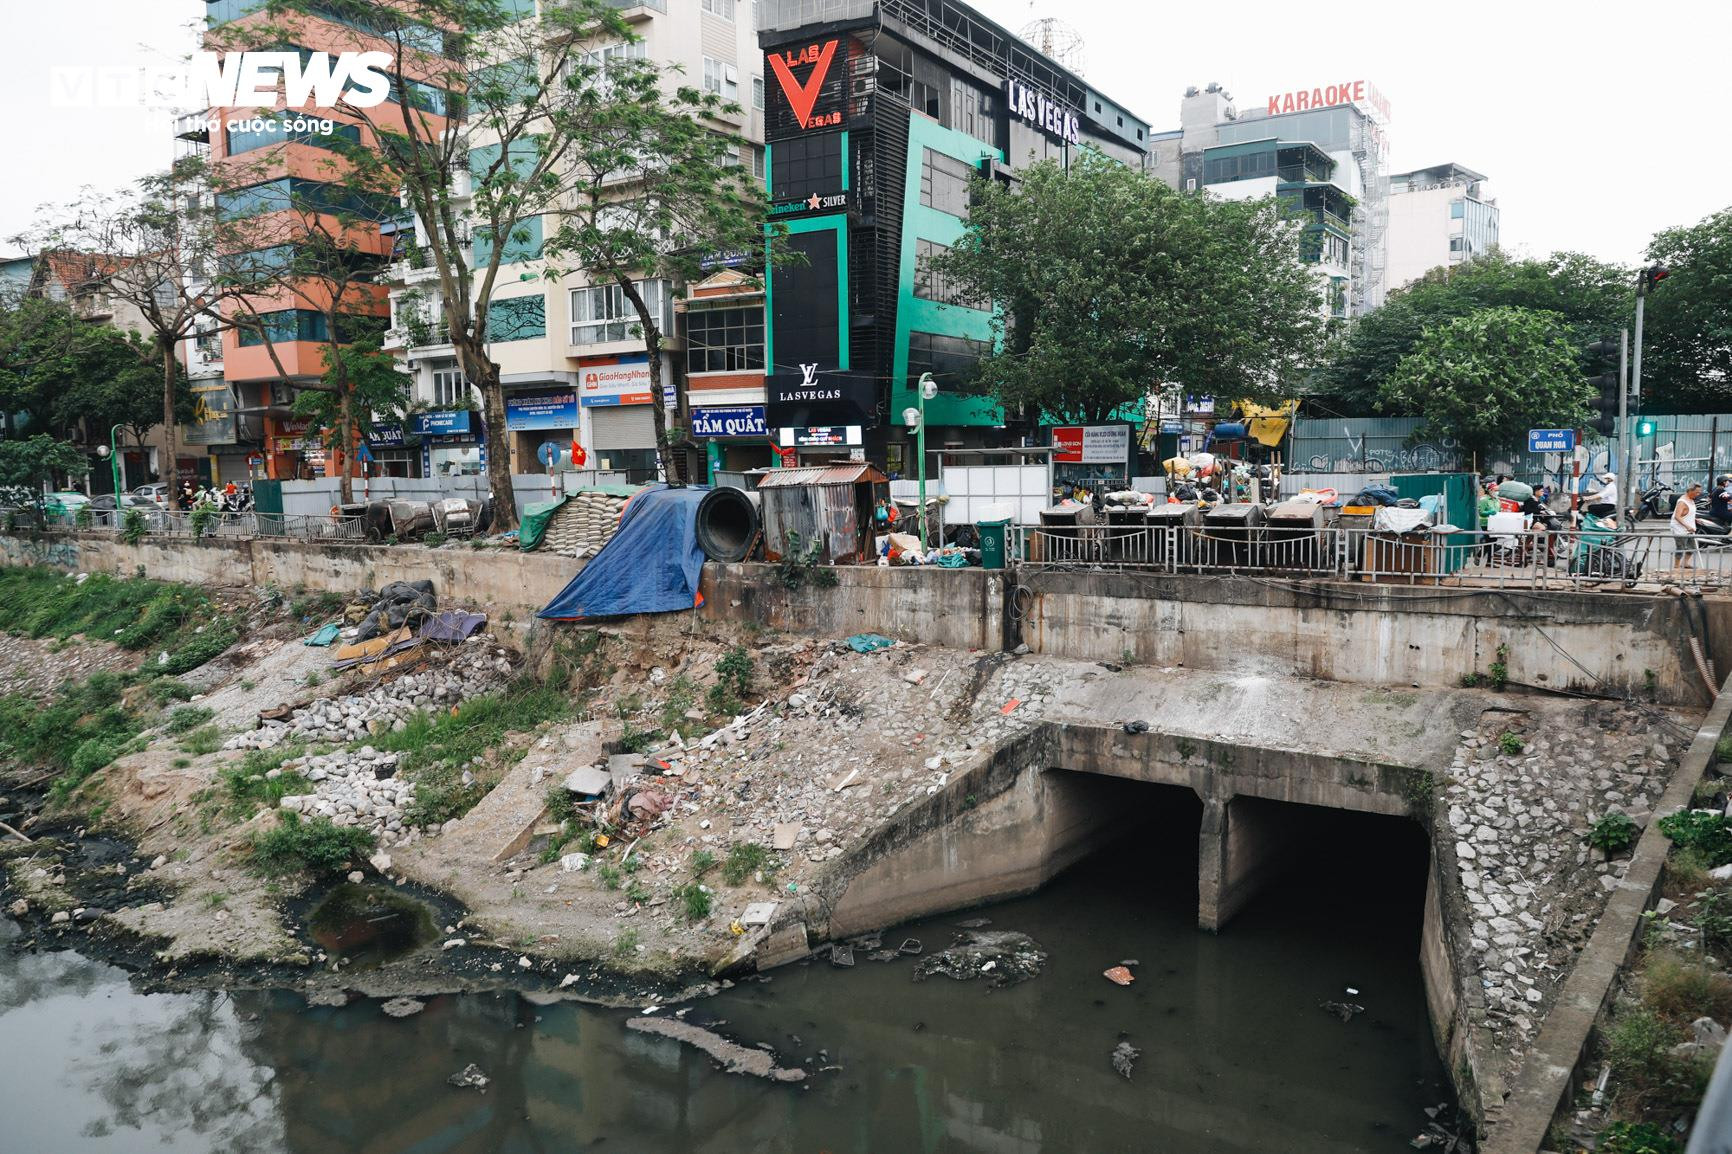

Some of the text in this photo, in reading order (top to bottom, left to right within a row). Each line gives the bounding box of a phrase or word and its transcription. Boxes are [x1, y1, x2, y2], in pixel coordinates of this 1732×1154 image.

[786, 44, 820, 68] LAS
[1267, 80, 1365, 115] KARAOKE
[767, 194, 846, 215] eineken SILVER
[692, 412, 764, 435] TẨM QUẤT
[1535, 441, 1566, 449] QUAN HOA
